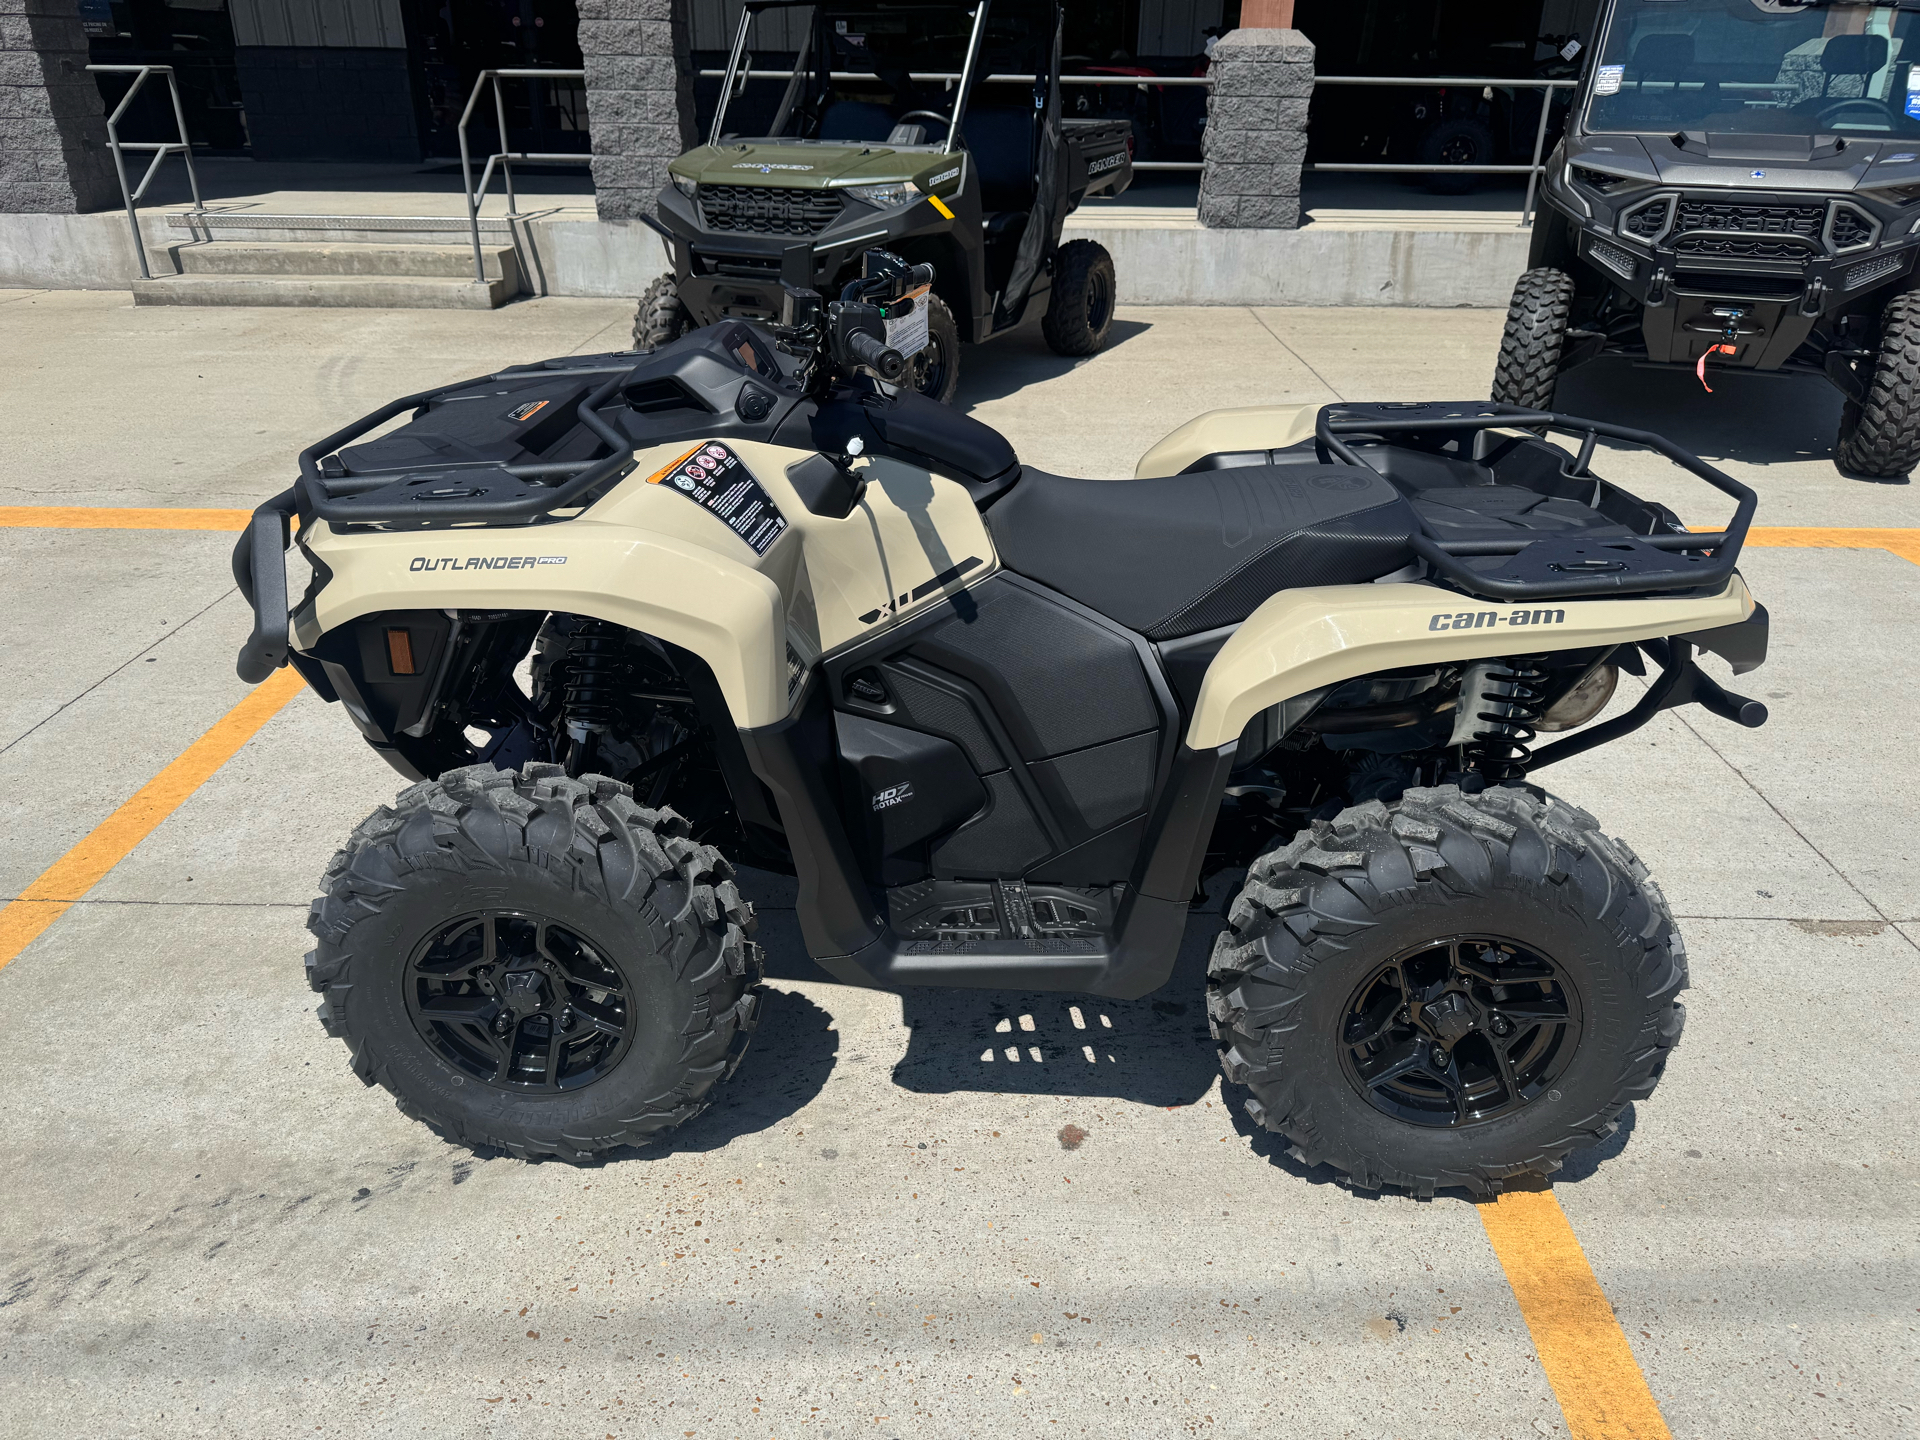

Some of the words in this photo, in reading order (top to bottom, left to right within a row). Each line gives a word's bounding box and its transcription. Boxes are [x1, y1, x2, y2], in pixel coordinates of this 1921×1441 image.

[732, 162, 814, 171] RANGER
[1087, 151, 1126, 175] RANGER
[928, 166, 960, 187] 1000
[715, 199, 804, 220] POLARIS
[1681, 213, 1815, 235] POLARIS
[409, 556, 537, 572] OUTLANDER
[538, 556, 567, 565] PRO
[1428, 609, 1566, 631] can-am
[872, 783, 910, 806] HD7
[872, 795, 902, 812] ROTAX
[554, 1092, 627, 1123] TRAIL
